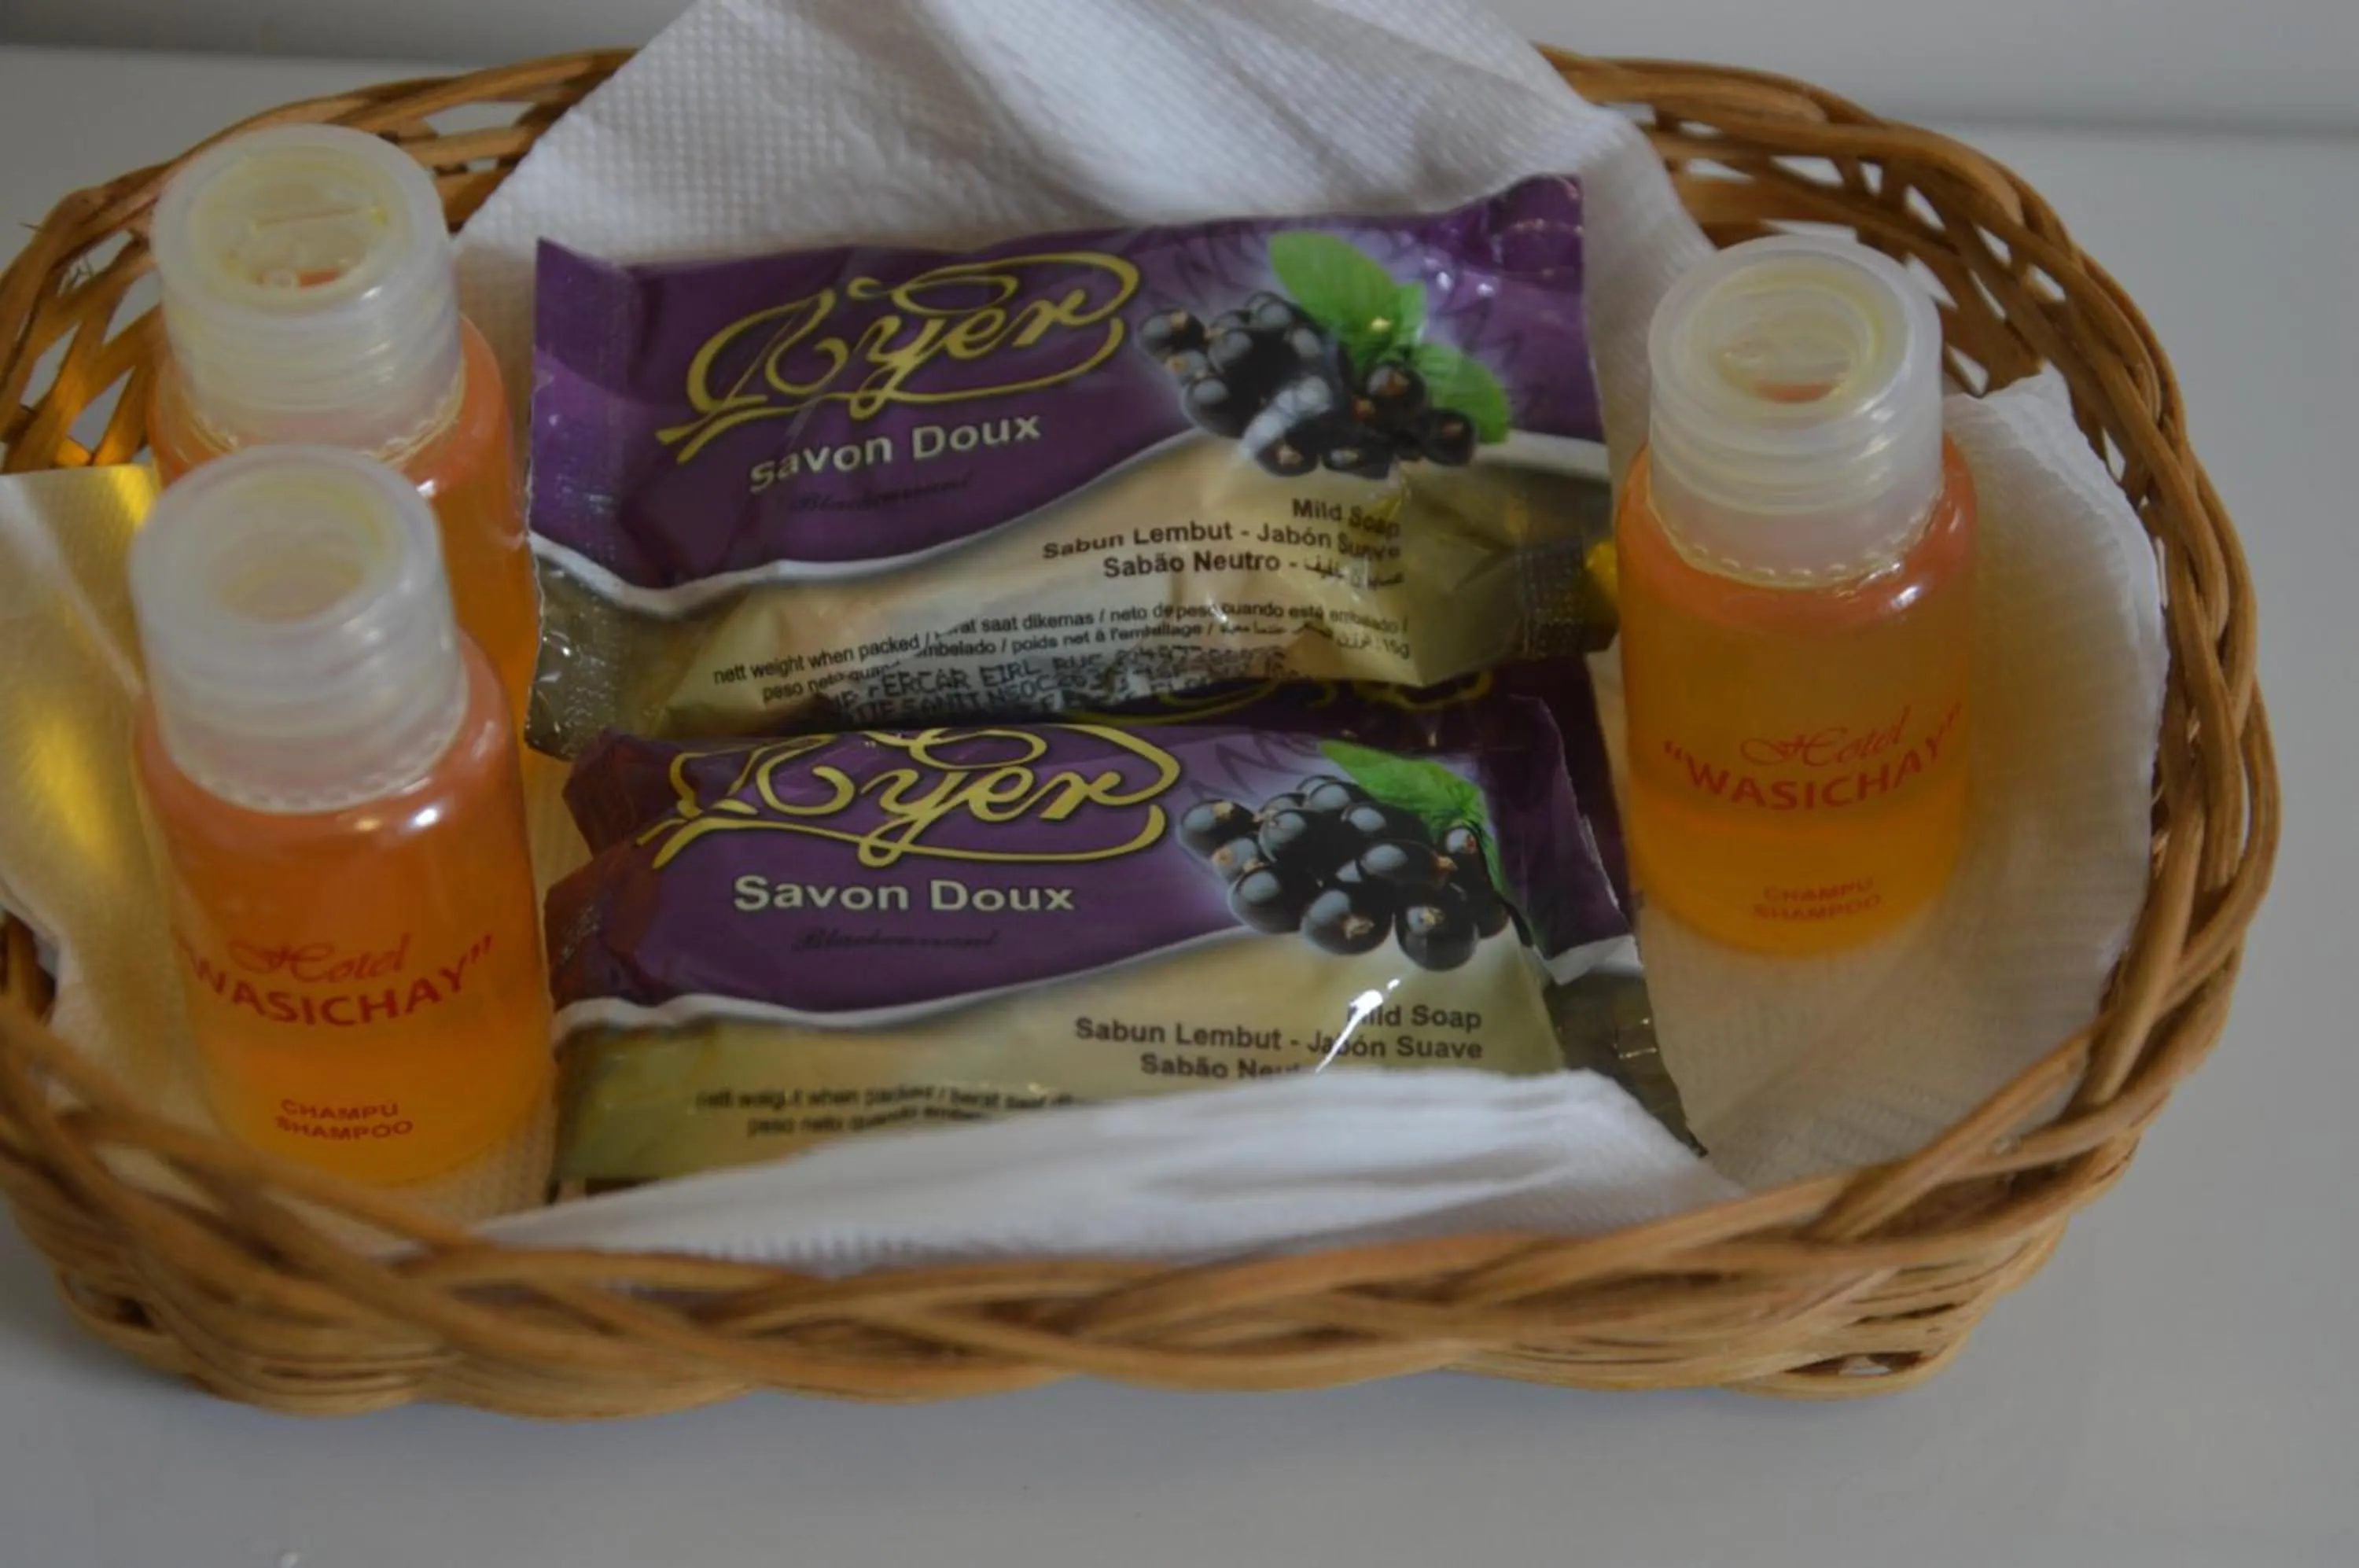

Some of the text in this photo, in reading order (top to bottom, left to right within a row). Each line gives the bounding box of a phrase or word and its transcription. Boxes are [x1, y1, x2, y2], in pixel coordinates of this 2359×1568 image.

[912, 414, 1041, 459] Doux
[1292, 498, 1342, 522] Mild
[1042, 532, 1124, 559] Sabun
[1133, 521, 1233, 547] Lembut
[1257, 521, 1331, 550] Jabón
[1103, 551, 1184, 580] Sabão
[1193, 550, 1281, 573] Neutro
[753, 655, 804, 681] weight
[807, 647, 854, 670] when
[859, 635, 921, 662] packed
[981, 615, 1018, 633] saat
[1110, 607, 1148, 623] neto
[733, 875, 1075, 911] Savon Doux
[1411, 1005, 1483, 1032] Soap
[1075, 1018, 1165, 1045] Sabun
[1176, 1023, 1282, 1051] Lembut
[1397, 1036, 1483, 1060] Suave
[1140, 1053, 1228, 1080] Sabão
[281, 1099, 399, 1121] CHAMPU
[275, 1117, 414, 1141] SHAMPOO
